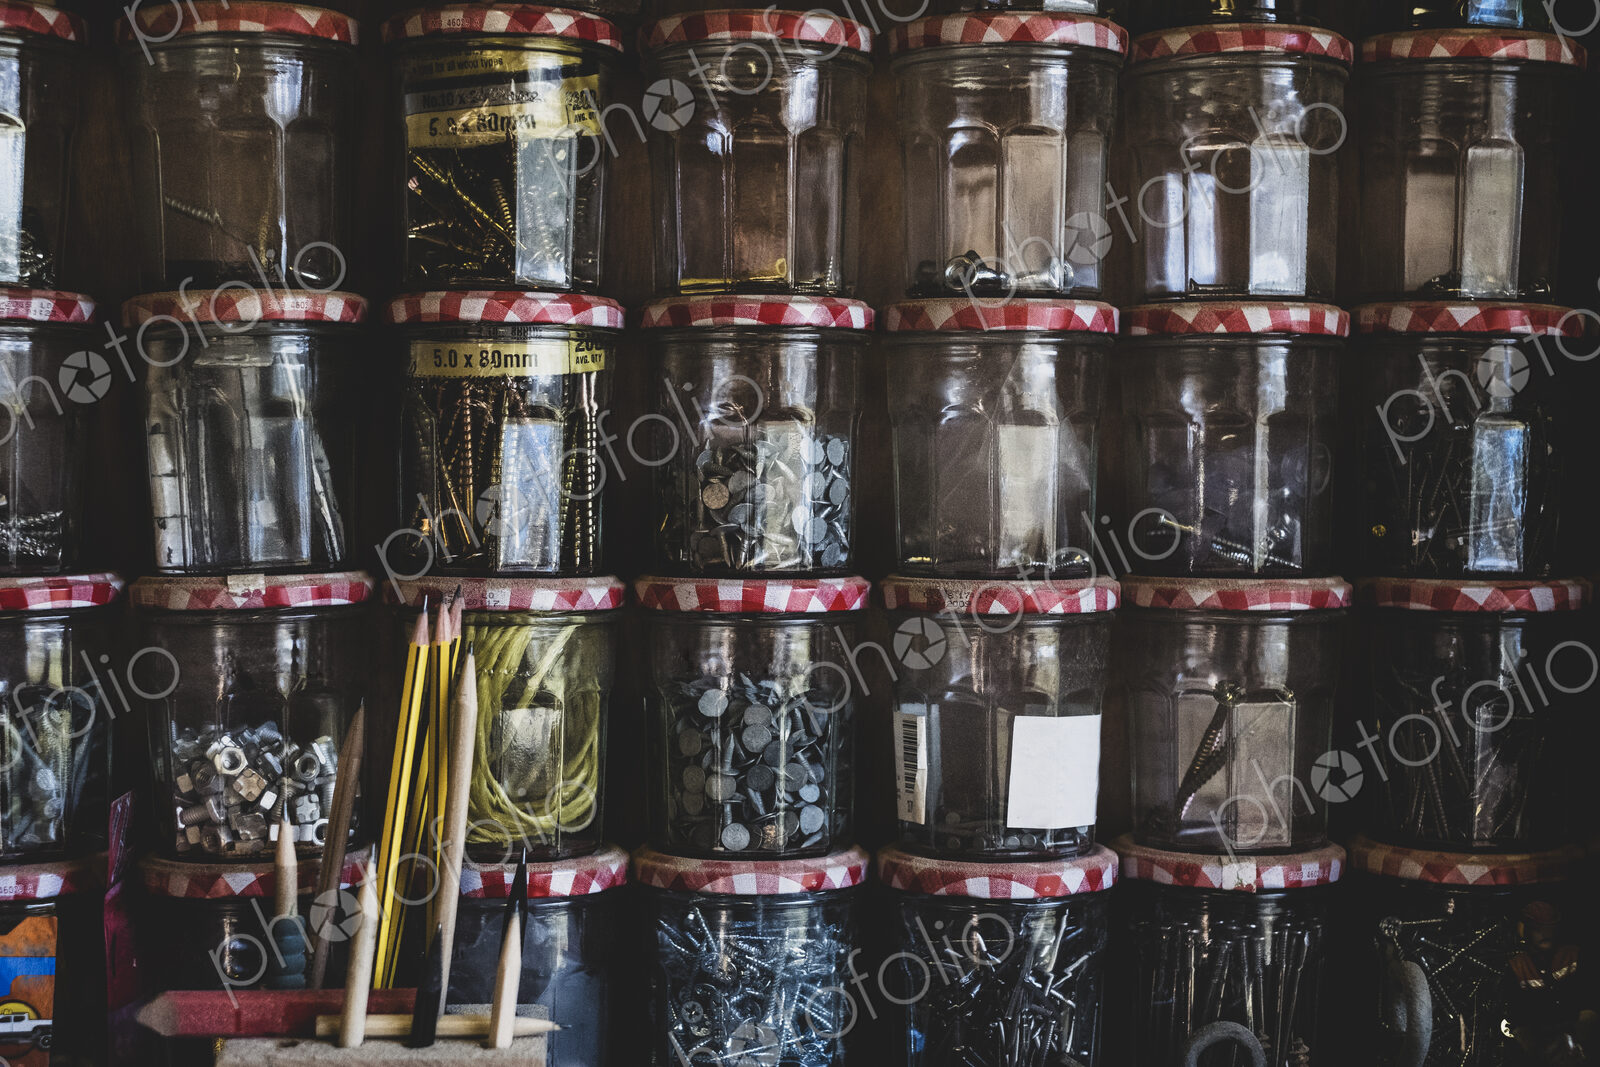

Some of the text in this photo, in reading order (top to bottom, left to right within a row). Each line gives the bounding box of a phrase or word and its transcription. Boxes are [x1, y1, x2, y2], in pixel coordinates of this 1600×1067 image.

[457, 58, 479, 69] wood
[481, 57, 504, 68] types
[433, 349, 538, 368] 5.0 x 80mm
[576, 353, 603, 365] AVG. QTY
